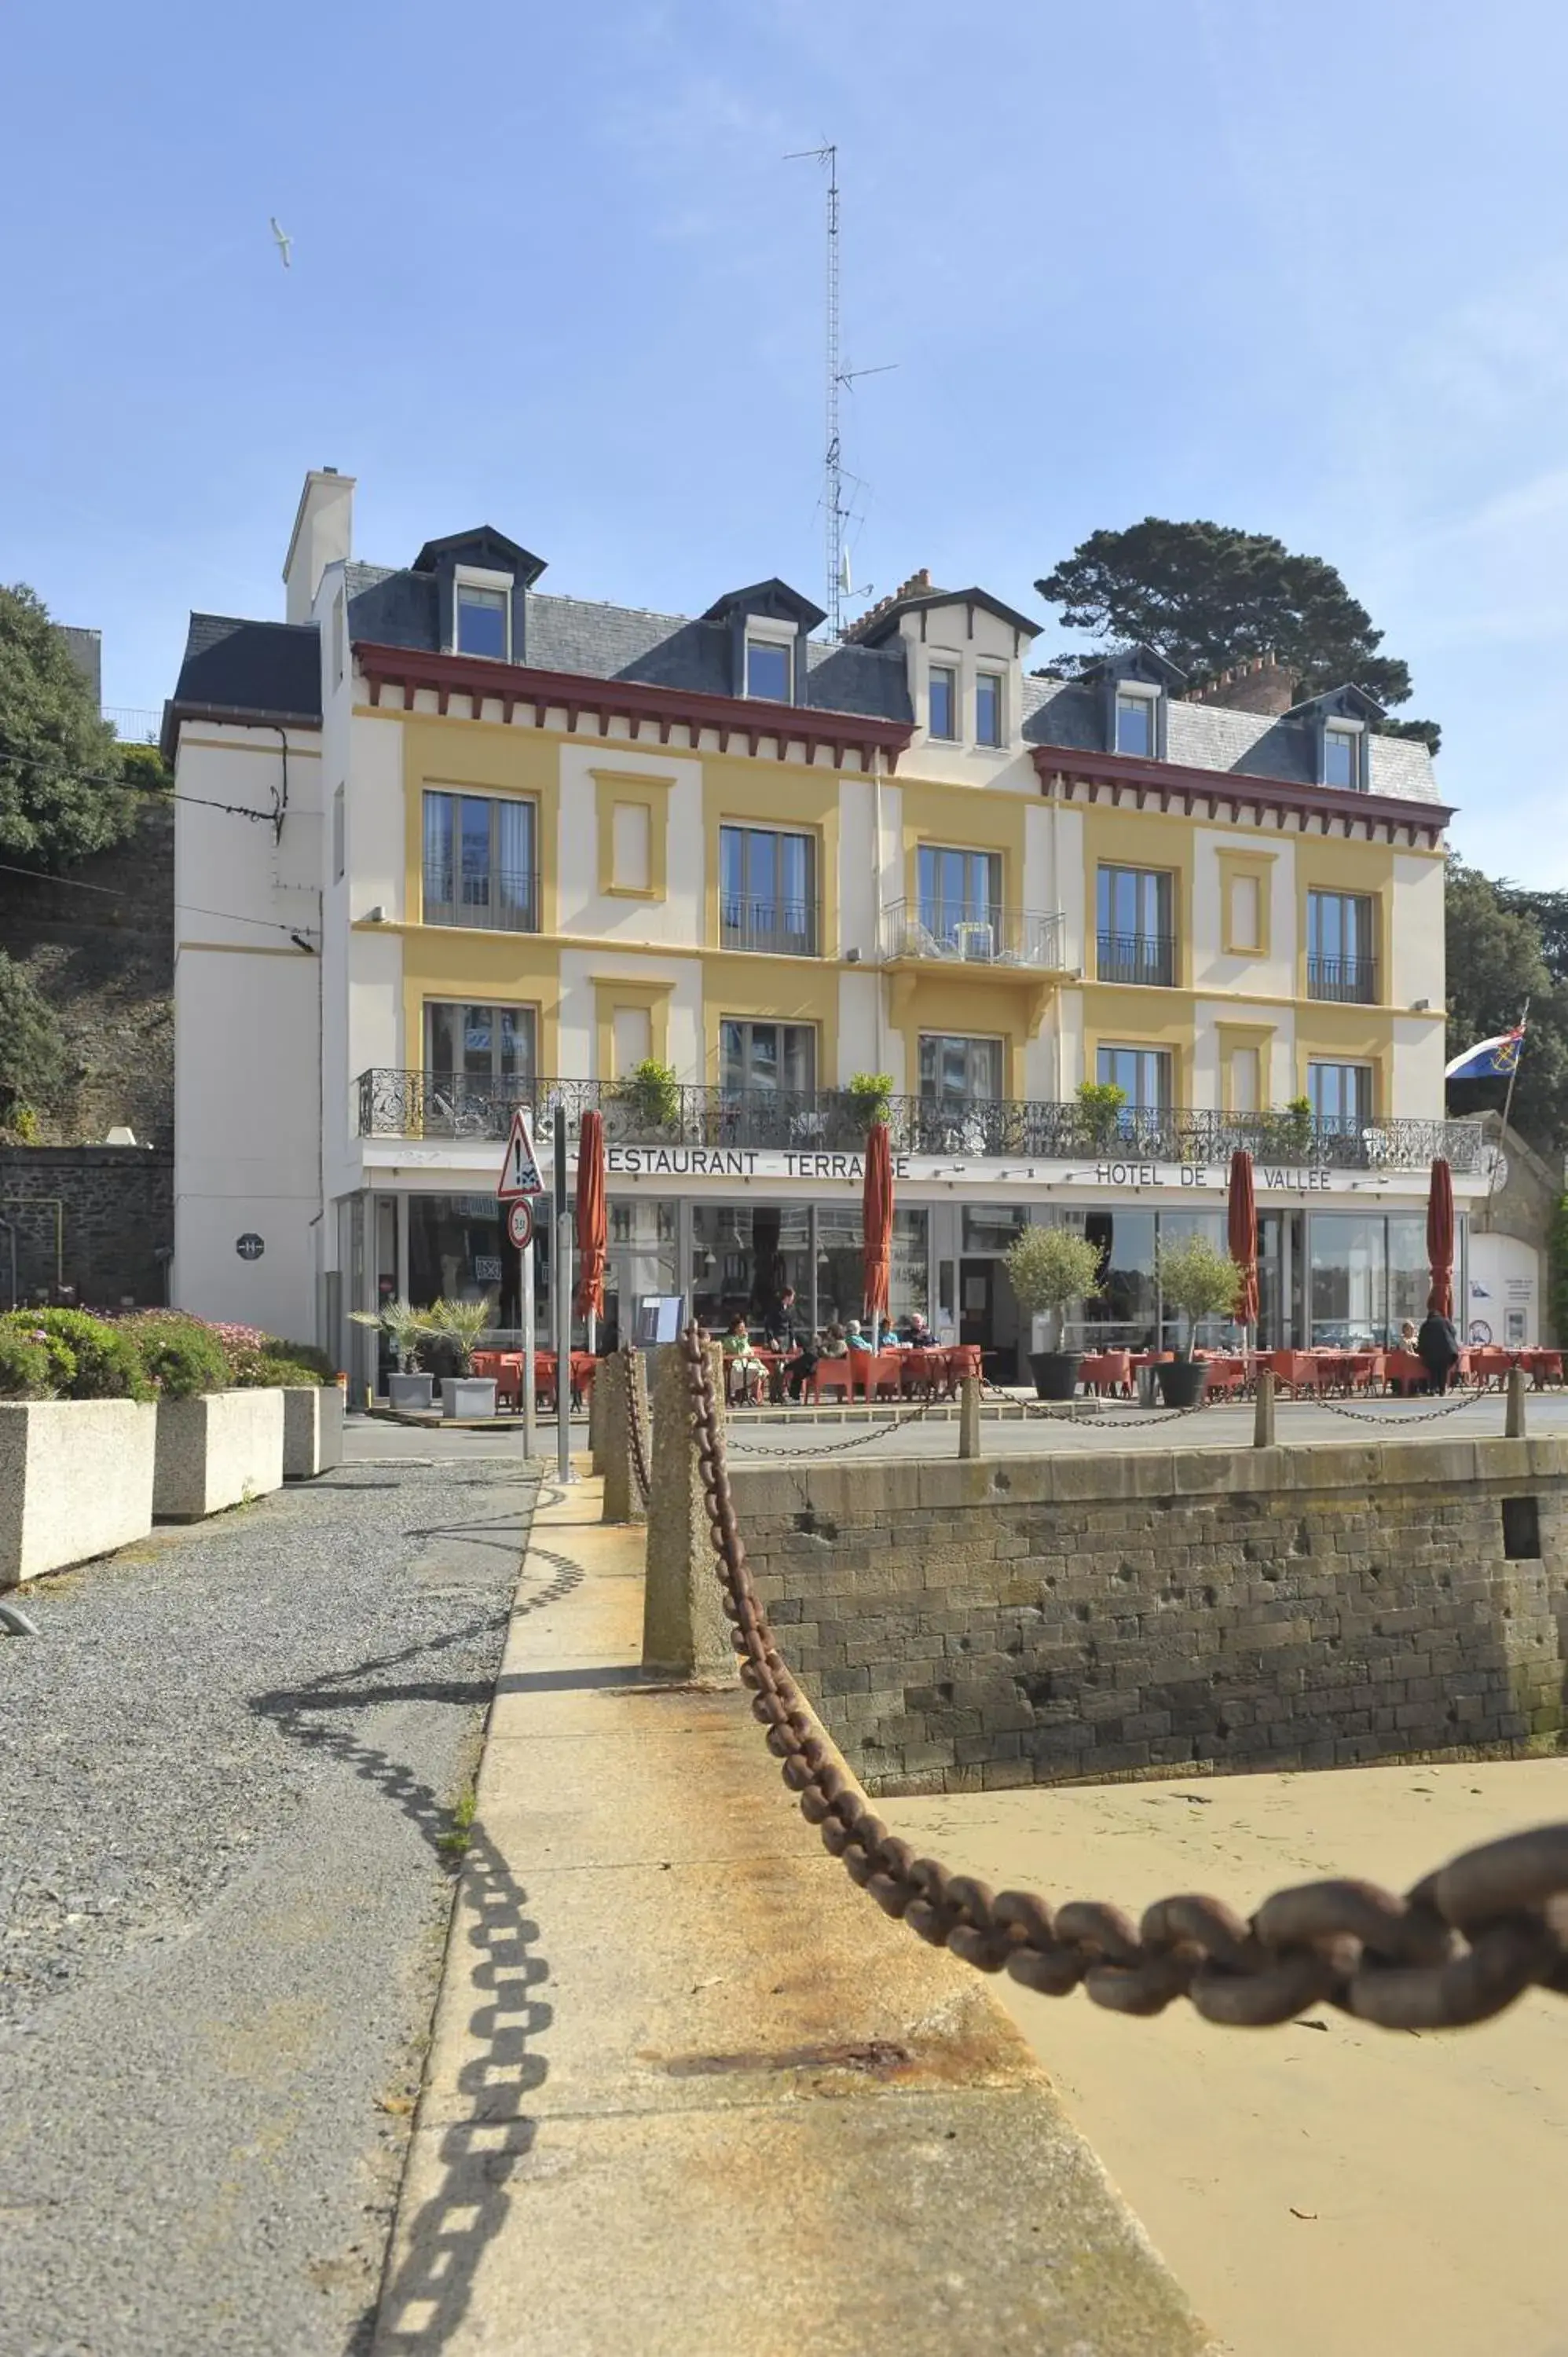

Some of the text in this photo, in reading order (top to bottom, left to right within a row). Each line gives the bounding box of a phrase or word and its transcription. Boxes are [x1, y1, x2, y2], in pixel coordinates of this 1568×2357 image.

[603, 1149, 910, 1178] ESTAURANT TERRAE
[1097, 1164, 1164, 1185] HOTEL
[1181, 1167, 1207, 1186] DE
[1264, 1168, 1331, 1189] VALLEE
